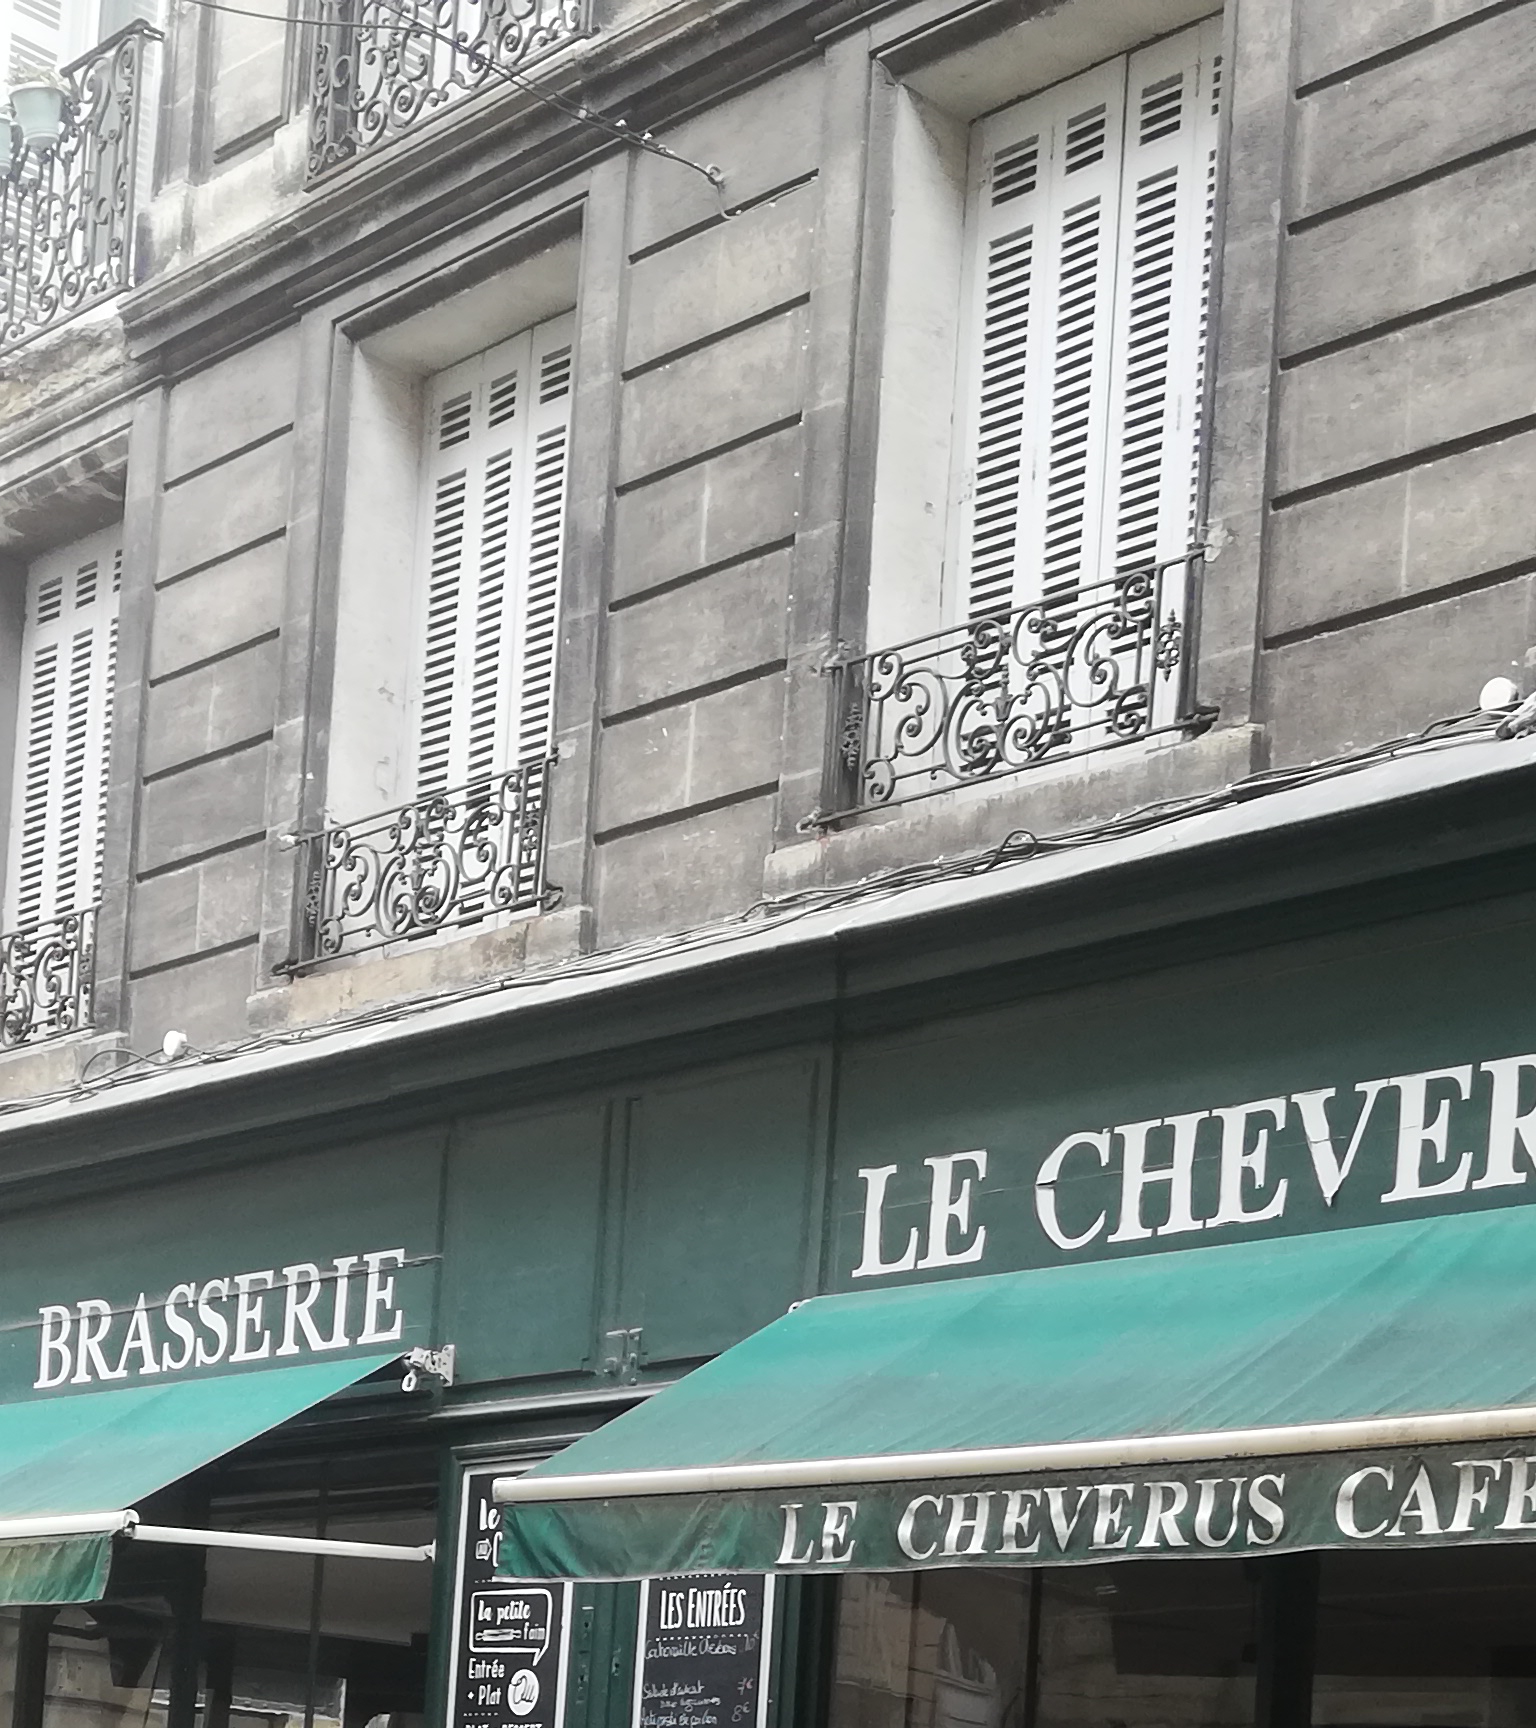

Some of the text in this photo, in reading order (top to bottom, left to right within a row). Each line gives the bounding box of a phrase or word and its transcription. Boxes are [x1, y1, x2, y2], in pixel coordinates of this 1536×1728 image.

[851, 1150, 986, 1280] LE
[34, 1247, 405, 1390] BRASSERIE
[775, 1501, 857, 1566] LE
[896, 1473, 1287, 1559] CHEVERUS
[496, 1600, 531, 1625] petite
[660, 1582, 746, 1630] LES ENTRÉES
[468, 1658, 505, 1680] Entrée
[478, 1684, 501, 1705] Plat
